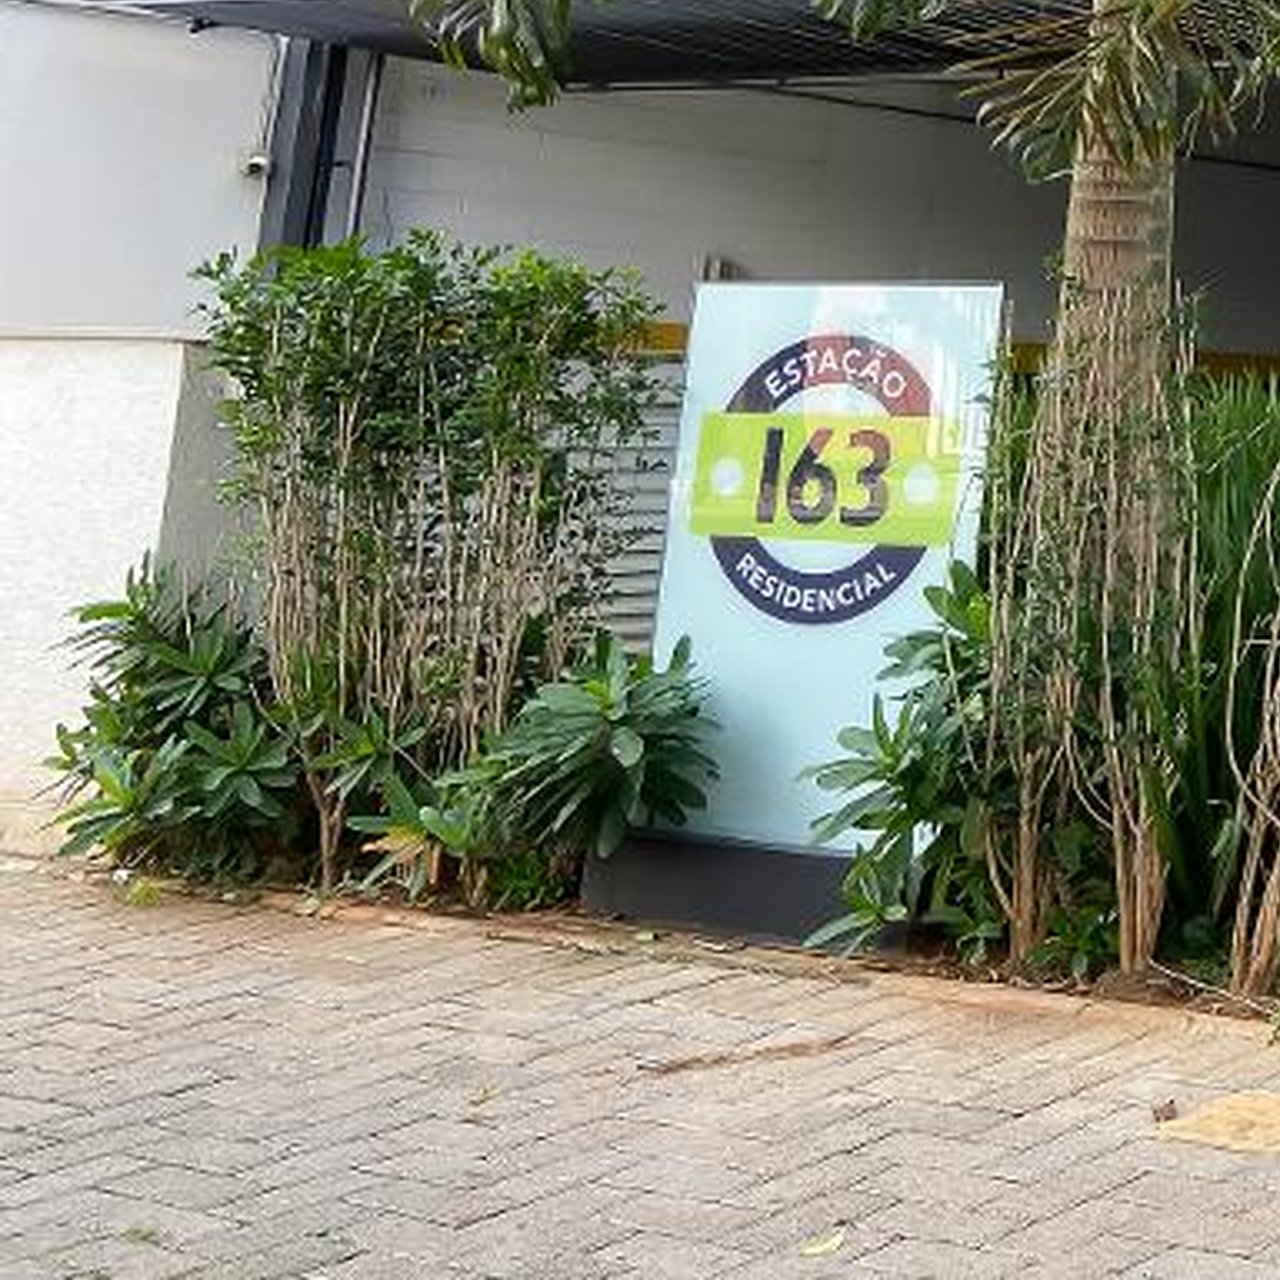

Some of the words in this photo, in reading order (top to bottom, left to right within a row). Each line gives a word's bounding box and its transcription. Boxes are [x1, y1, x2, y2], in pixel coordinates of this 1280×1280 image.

[765, 348, 906, 398] ESTAÇÃO
[756, 426, 892, 527] 163
[735, 552, 897, 613] RESIDENCIAL
